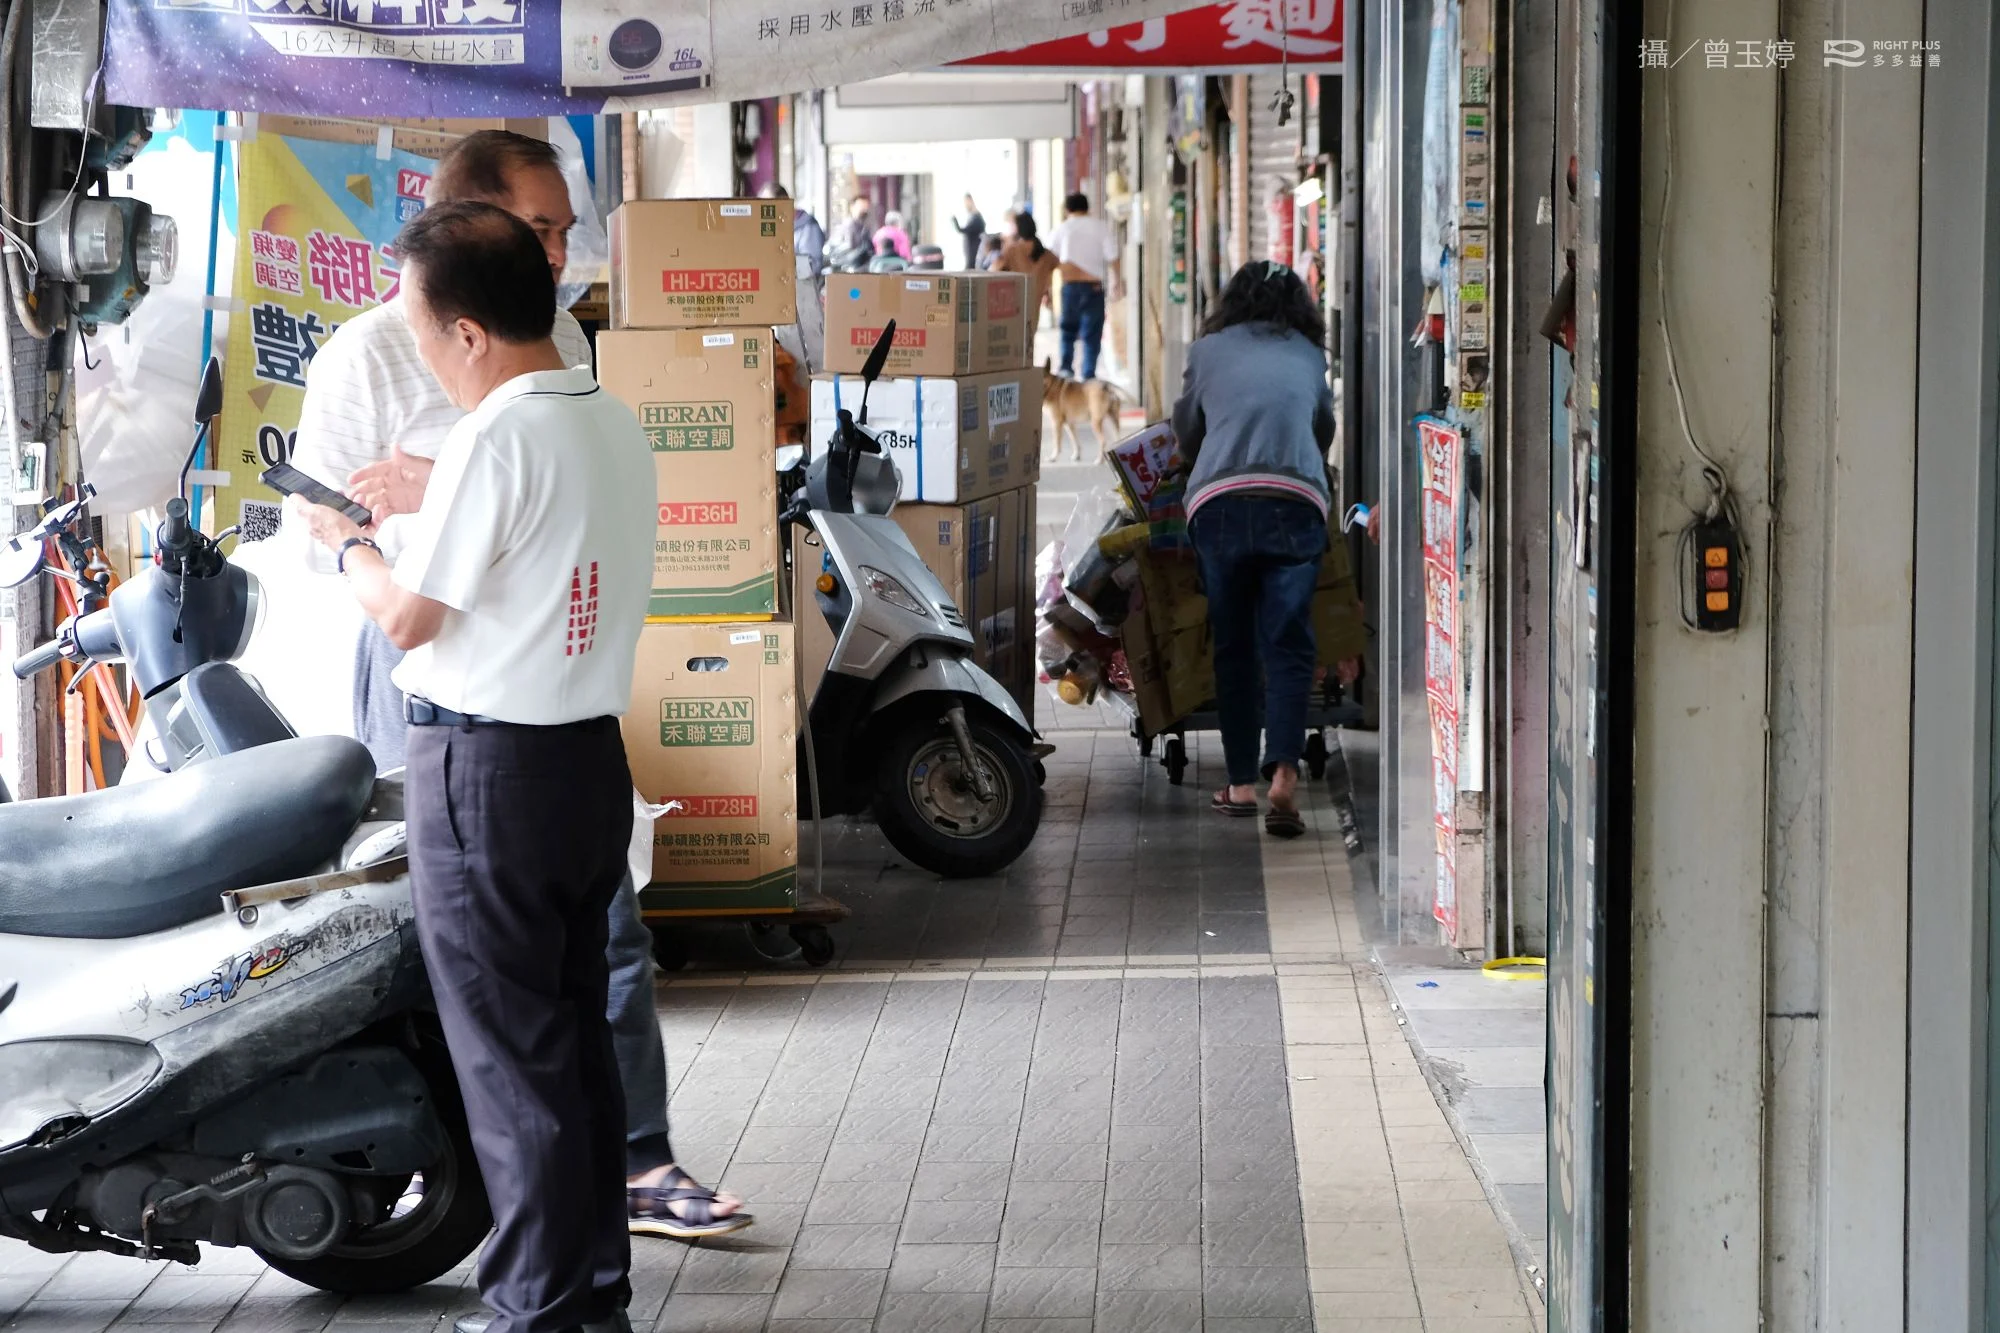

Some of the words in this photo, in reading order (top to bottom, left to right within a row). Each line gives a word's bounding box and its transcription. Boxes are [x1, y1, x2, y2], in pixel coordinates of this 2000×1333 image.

[757, 0, 968, 40] 採用水壓穩流
[281, 30, 515, 63] 16公升超大出水量
[674, 48, 697, 61] 16L
[670, 272, 752, 290] HI-JT36H
[857, 330, 920, 345] HI-28H
[644, 405, 728, 424] HERAN
[647, 428, 731, 448] 禾聯空調
[659, 504, 734, 524] O-JT36H
[656, 539, 750, 552] 碩股份有限公司
[664, 700, 749, 720] HERAN
[664, 723, 751, 744] 禾聯空調
